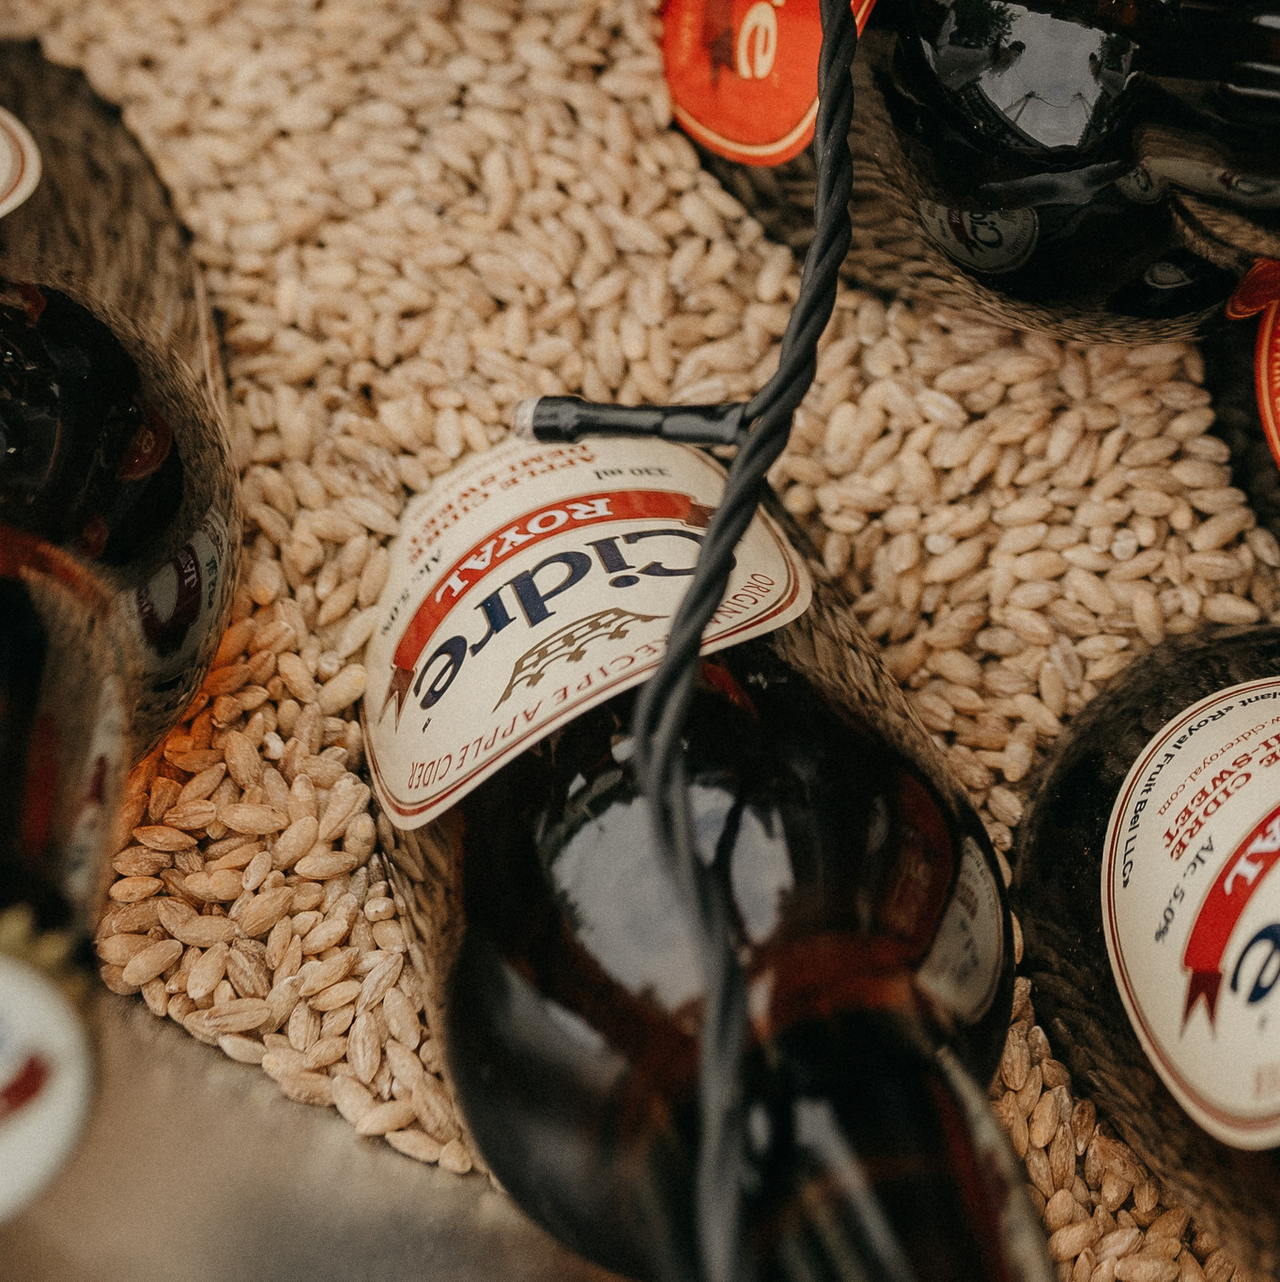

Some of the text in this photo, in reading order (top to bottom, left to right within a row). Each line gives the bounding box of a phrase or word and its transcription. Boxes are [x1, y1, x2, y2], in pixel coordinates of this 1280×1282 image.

[435, 497, 614, 604] ROYAL
[413, 527, 738, 712] Cidre
[709, 572, 776, 625] ORIGIN
[455, 699, 544, 771] APPLE
[407, 757, 453, 790] CIDER
[1145, 751, 1177, 796] Fruit
[1128, 797, 1149, 833] Bel
[1170, 771, 1253, 862] CIDRE
[1155, 835, 1215, 948] Alc. 5.0%
